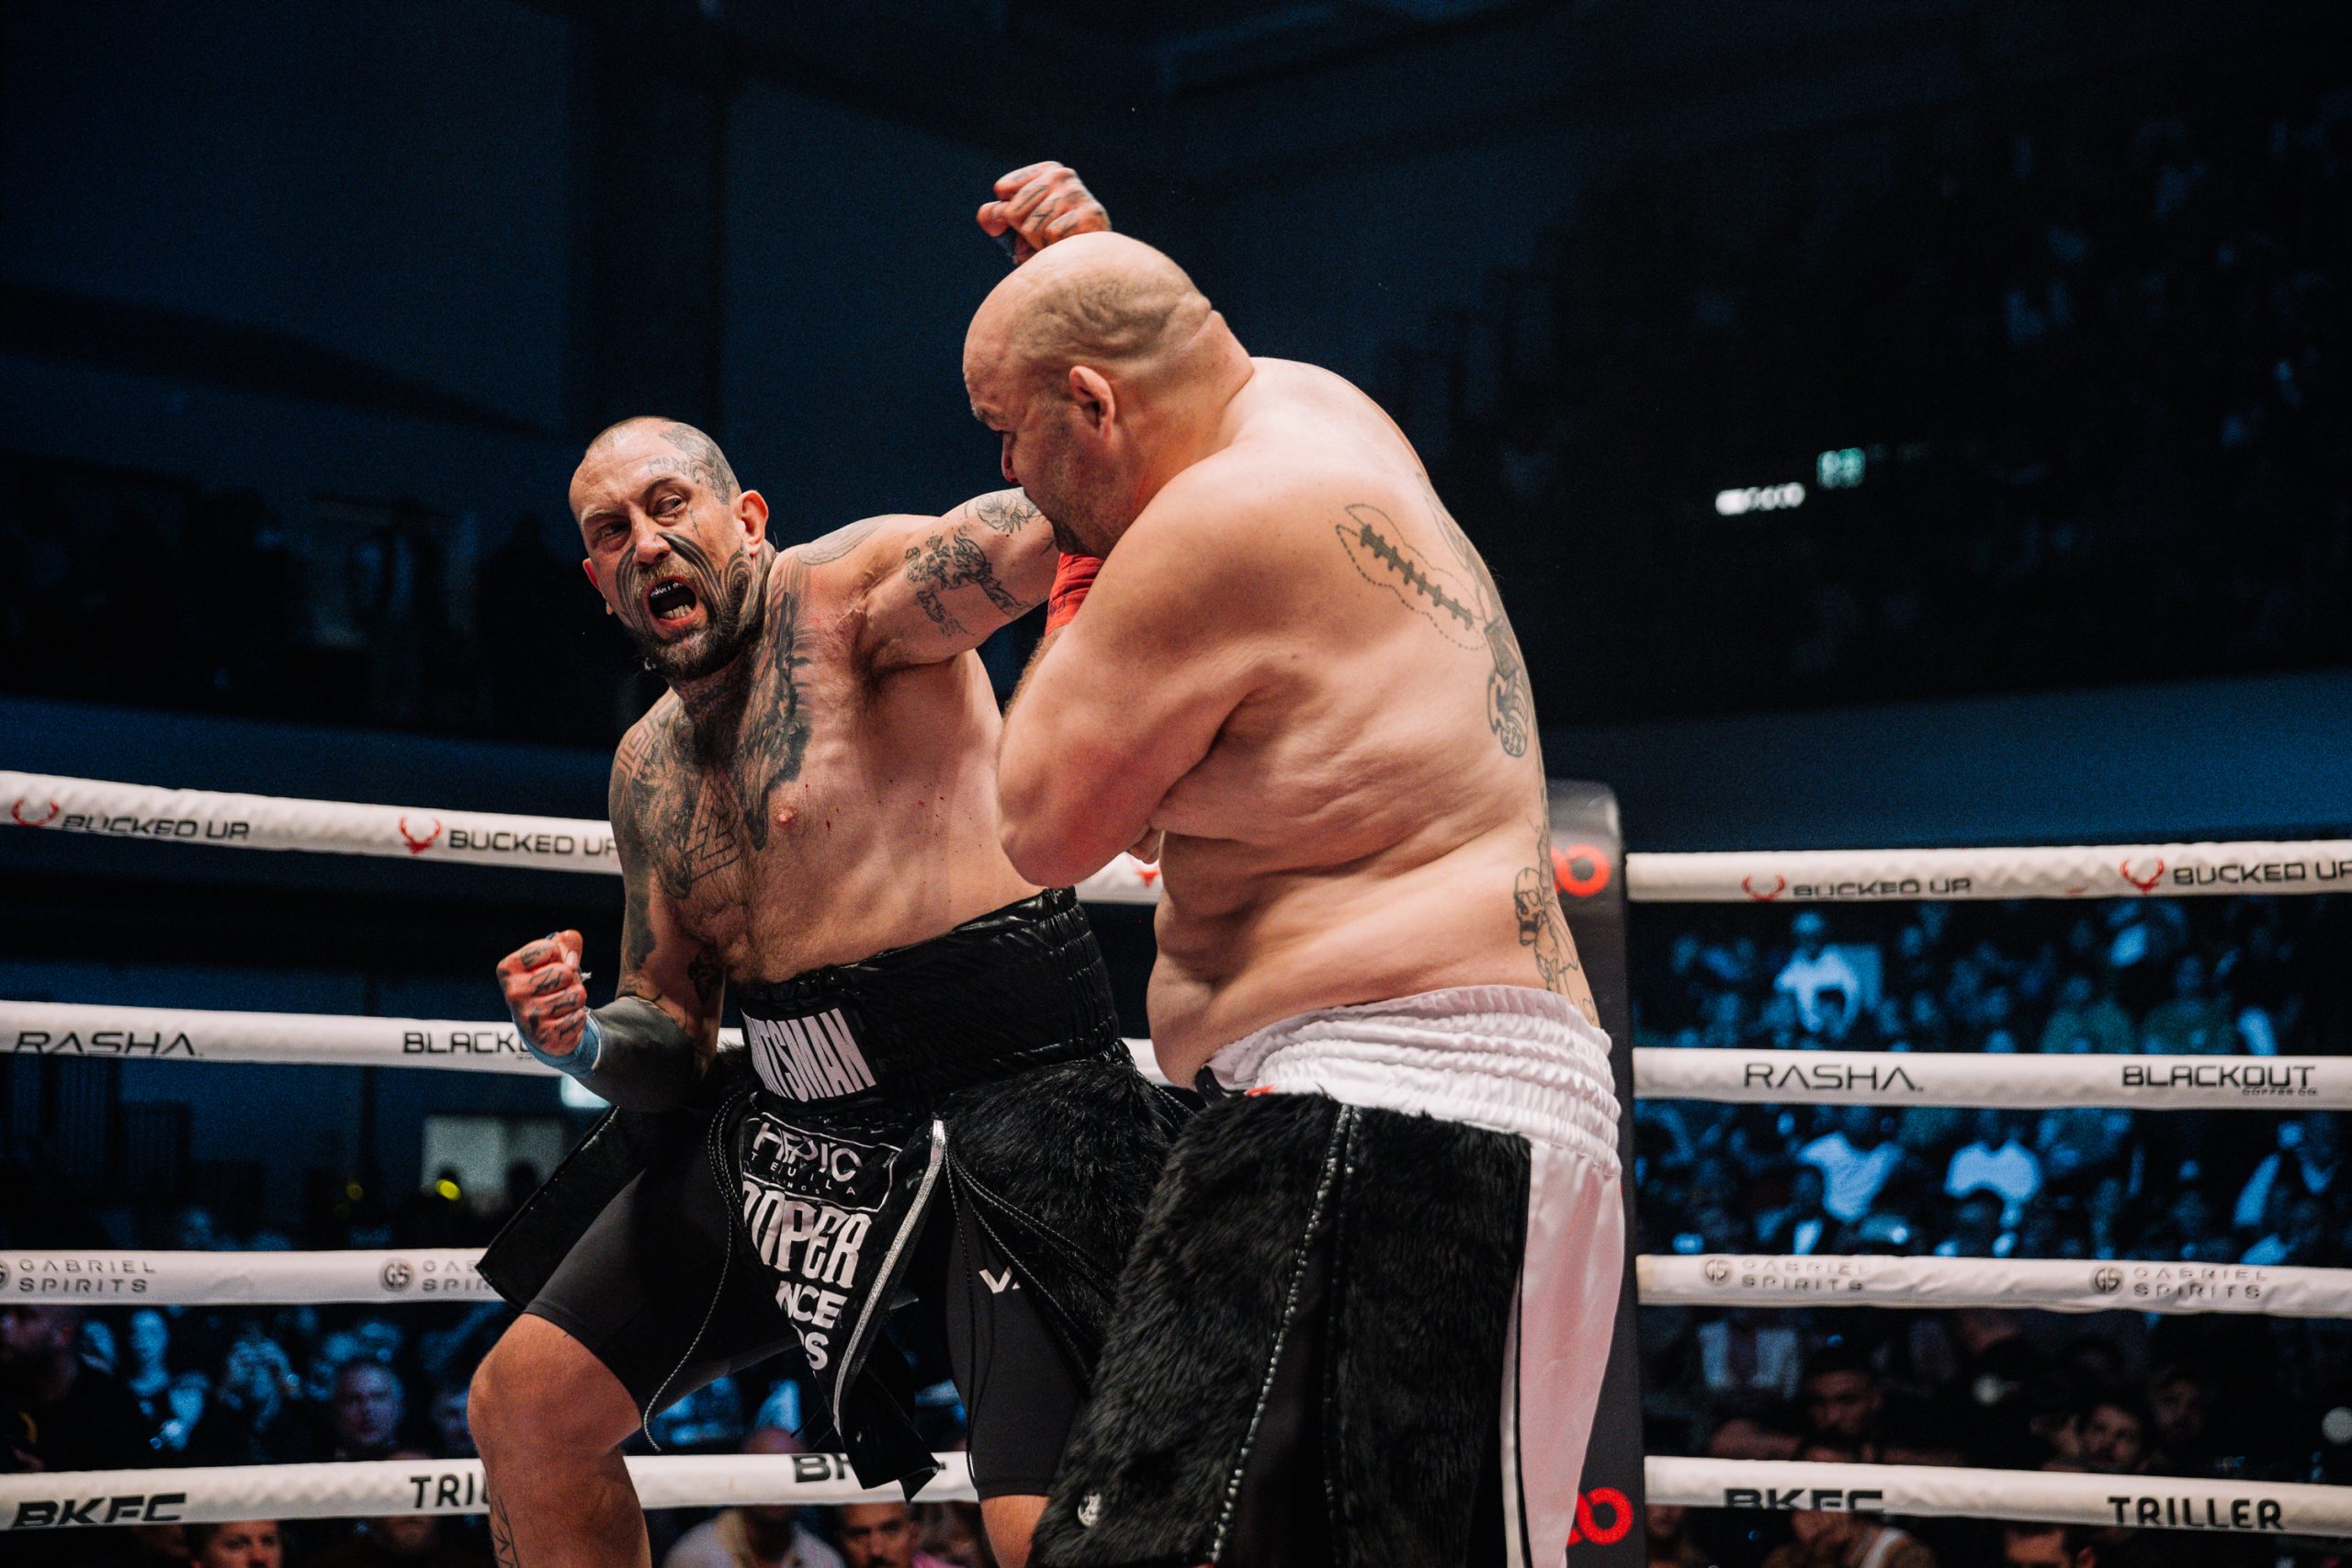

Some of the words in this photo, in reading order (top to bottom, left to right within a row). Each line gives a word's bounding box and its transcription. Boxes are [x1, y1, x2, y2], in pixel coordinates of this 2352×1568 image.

[448, 829, 575, 855] BUCKED
[2172, 863, 2307, 886] BUCKED
[1792, 877, 1921, 897] BUCKED
[2121, 1064, 2317, 1088] BLACKOUT
[18, 1258, 156, 1274] GABRIEL
[1742, 1258, 1867, 1276] GABRIEL
[2133, 1267, 2268, 1281] GABRIEL
[18, 1278, 149, 1293] SPIRITS
[1742, 1274, 1862, 1292] SPIRITS
[2133, 1282, 2262, 1300] SPIRITS
[1724, 1487, 1883, 1511] BKFC
[11, 1492, 187, 1529] BKFC
[2107, 1496, 2285, 1531] TRILLER
